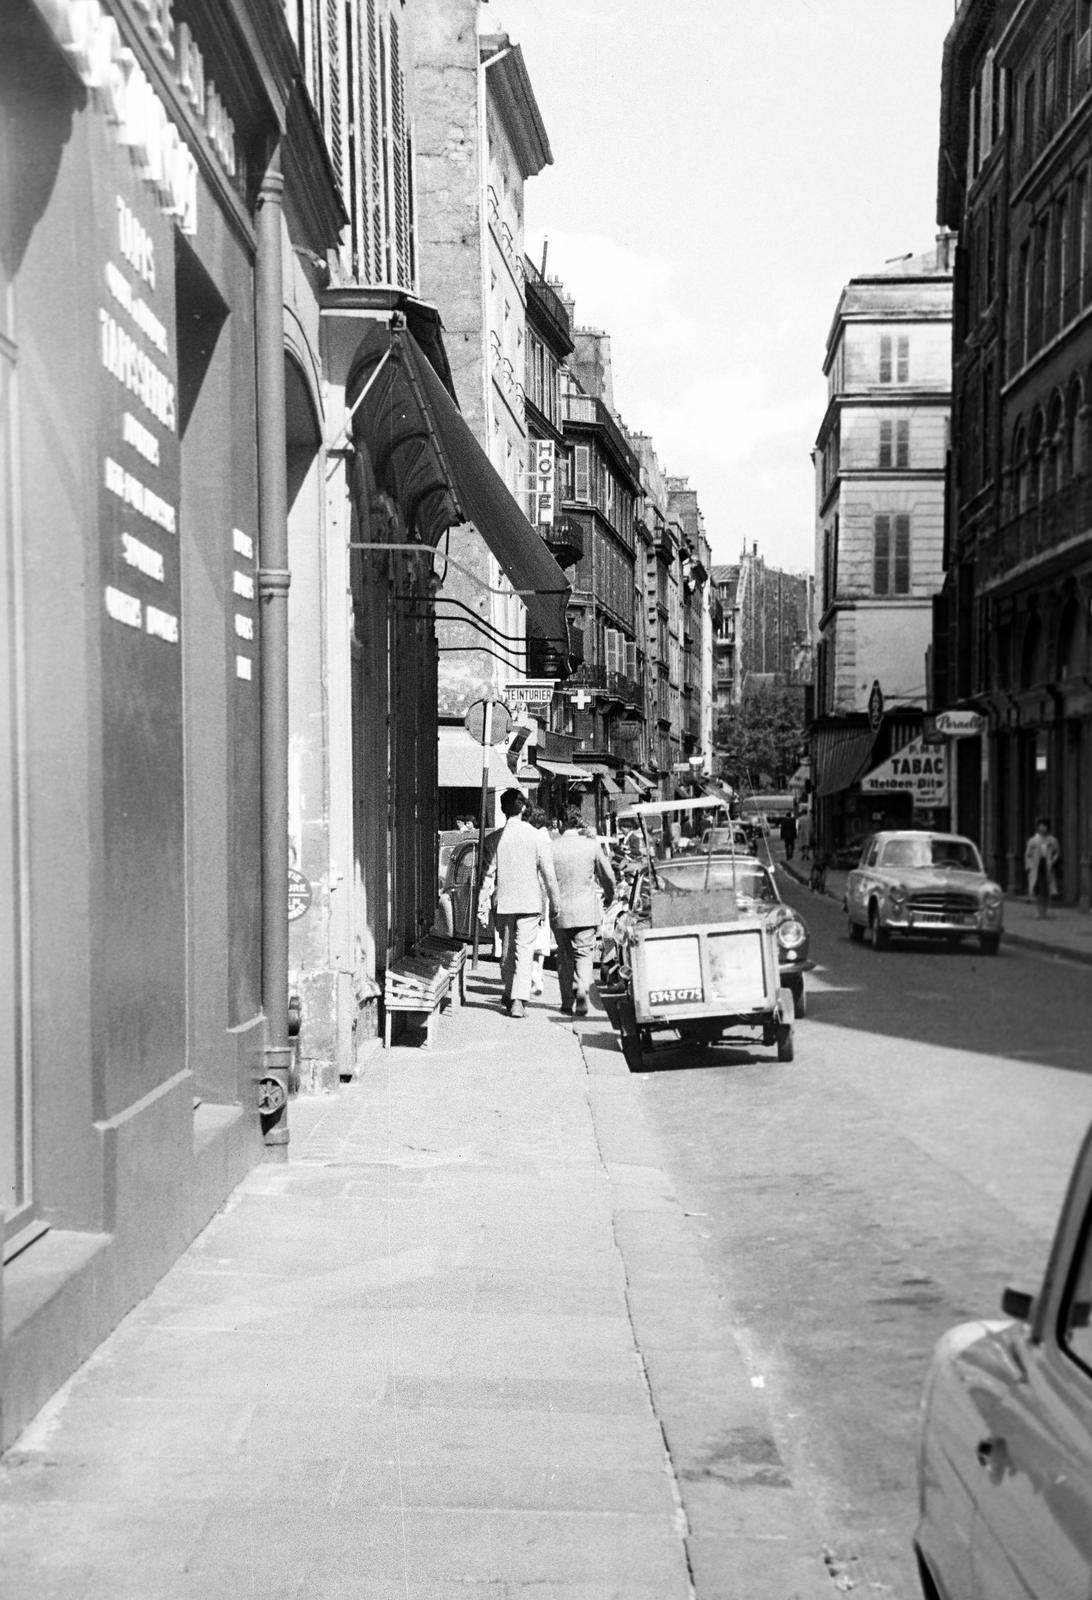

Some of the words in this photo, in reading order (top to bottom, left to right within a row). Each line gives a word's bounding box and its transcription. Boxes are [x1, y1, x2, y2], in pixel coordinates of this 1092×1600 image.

[538, 442, 552, 525] HOTEL
[503, 690, 550, 700] TEINTURIER
[891, 758, 943, 774] TABAC
